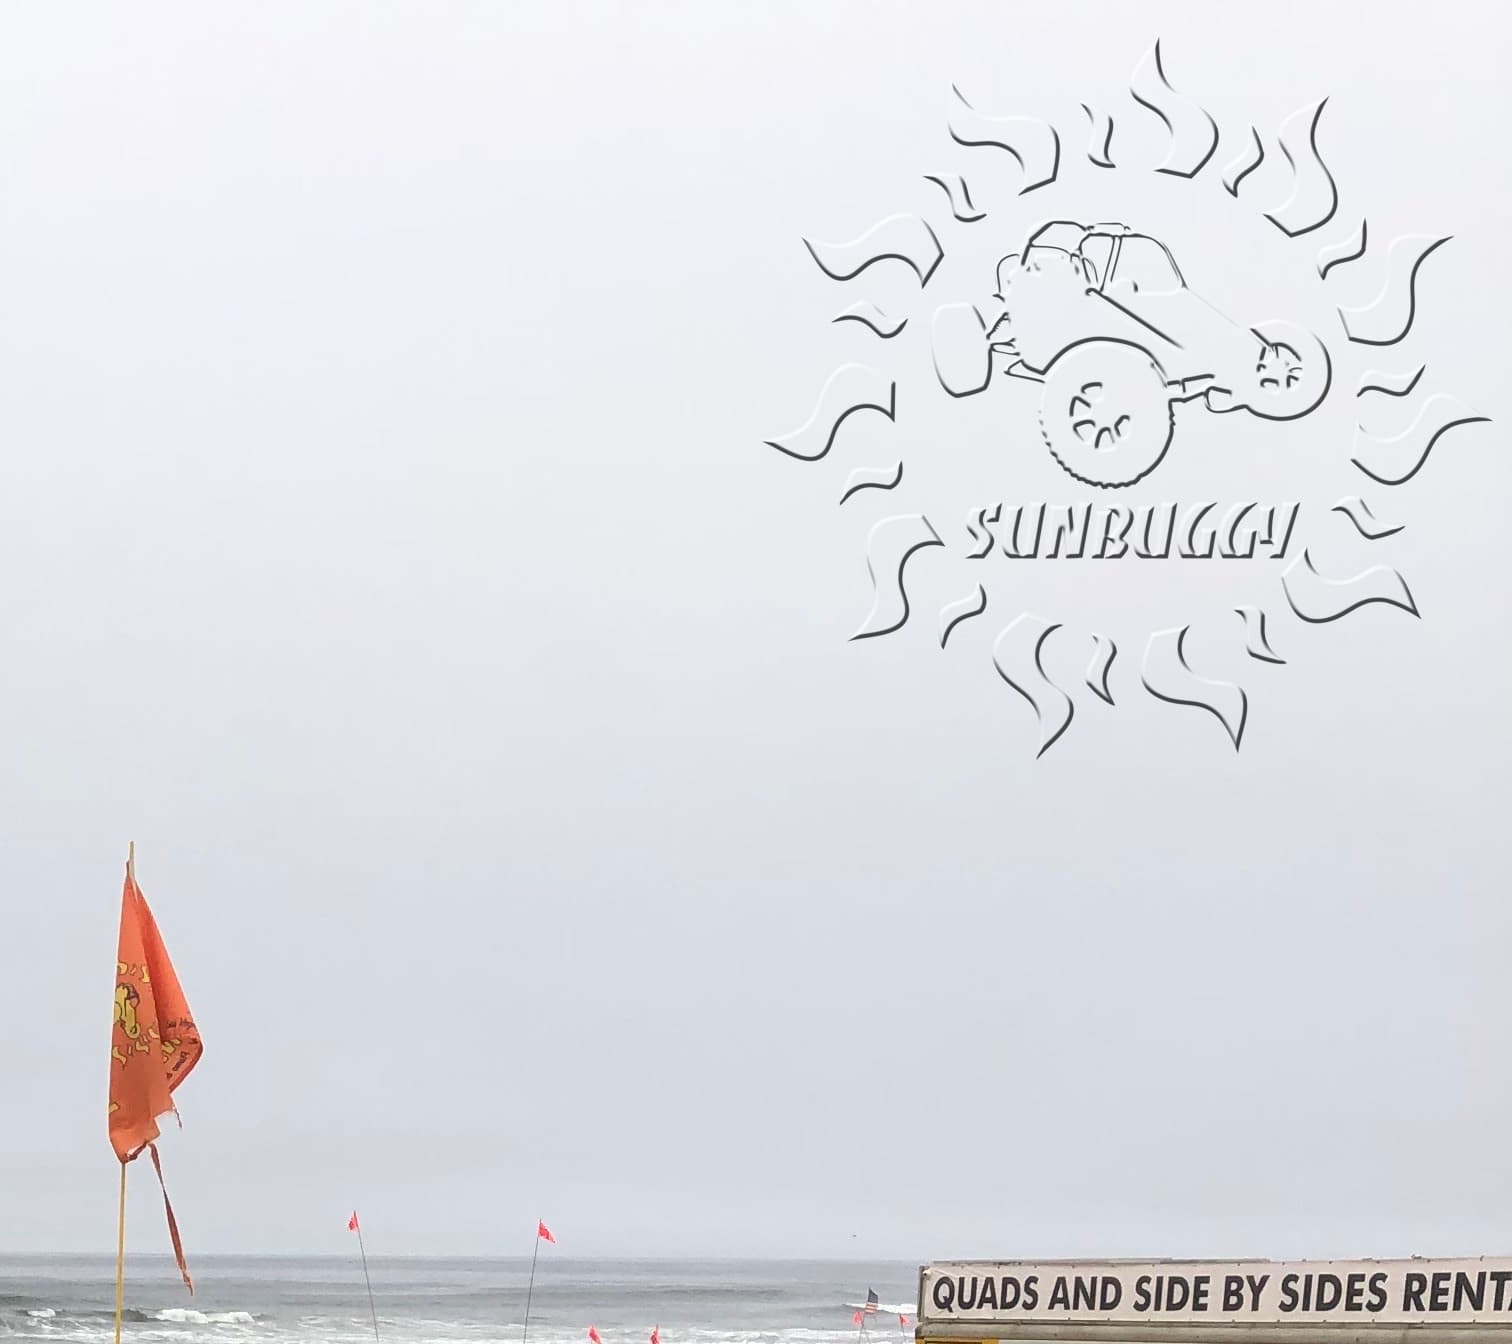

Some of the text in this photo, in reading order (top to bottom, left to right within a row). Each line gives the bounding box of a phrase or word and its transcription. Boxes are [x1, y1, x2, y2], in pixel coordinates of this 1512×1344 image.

[933, 1270, 1512, 1313] QUADS AND SIDE BY SIDES RENT
